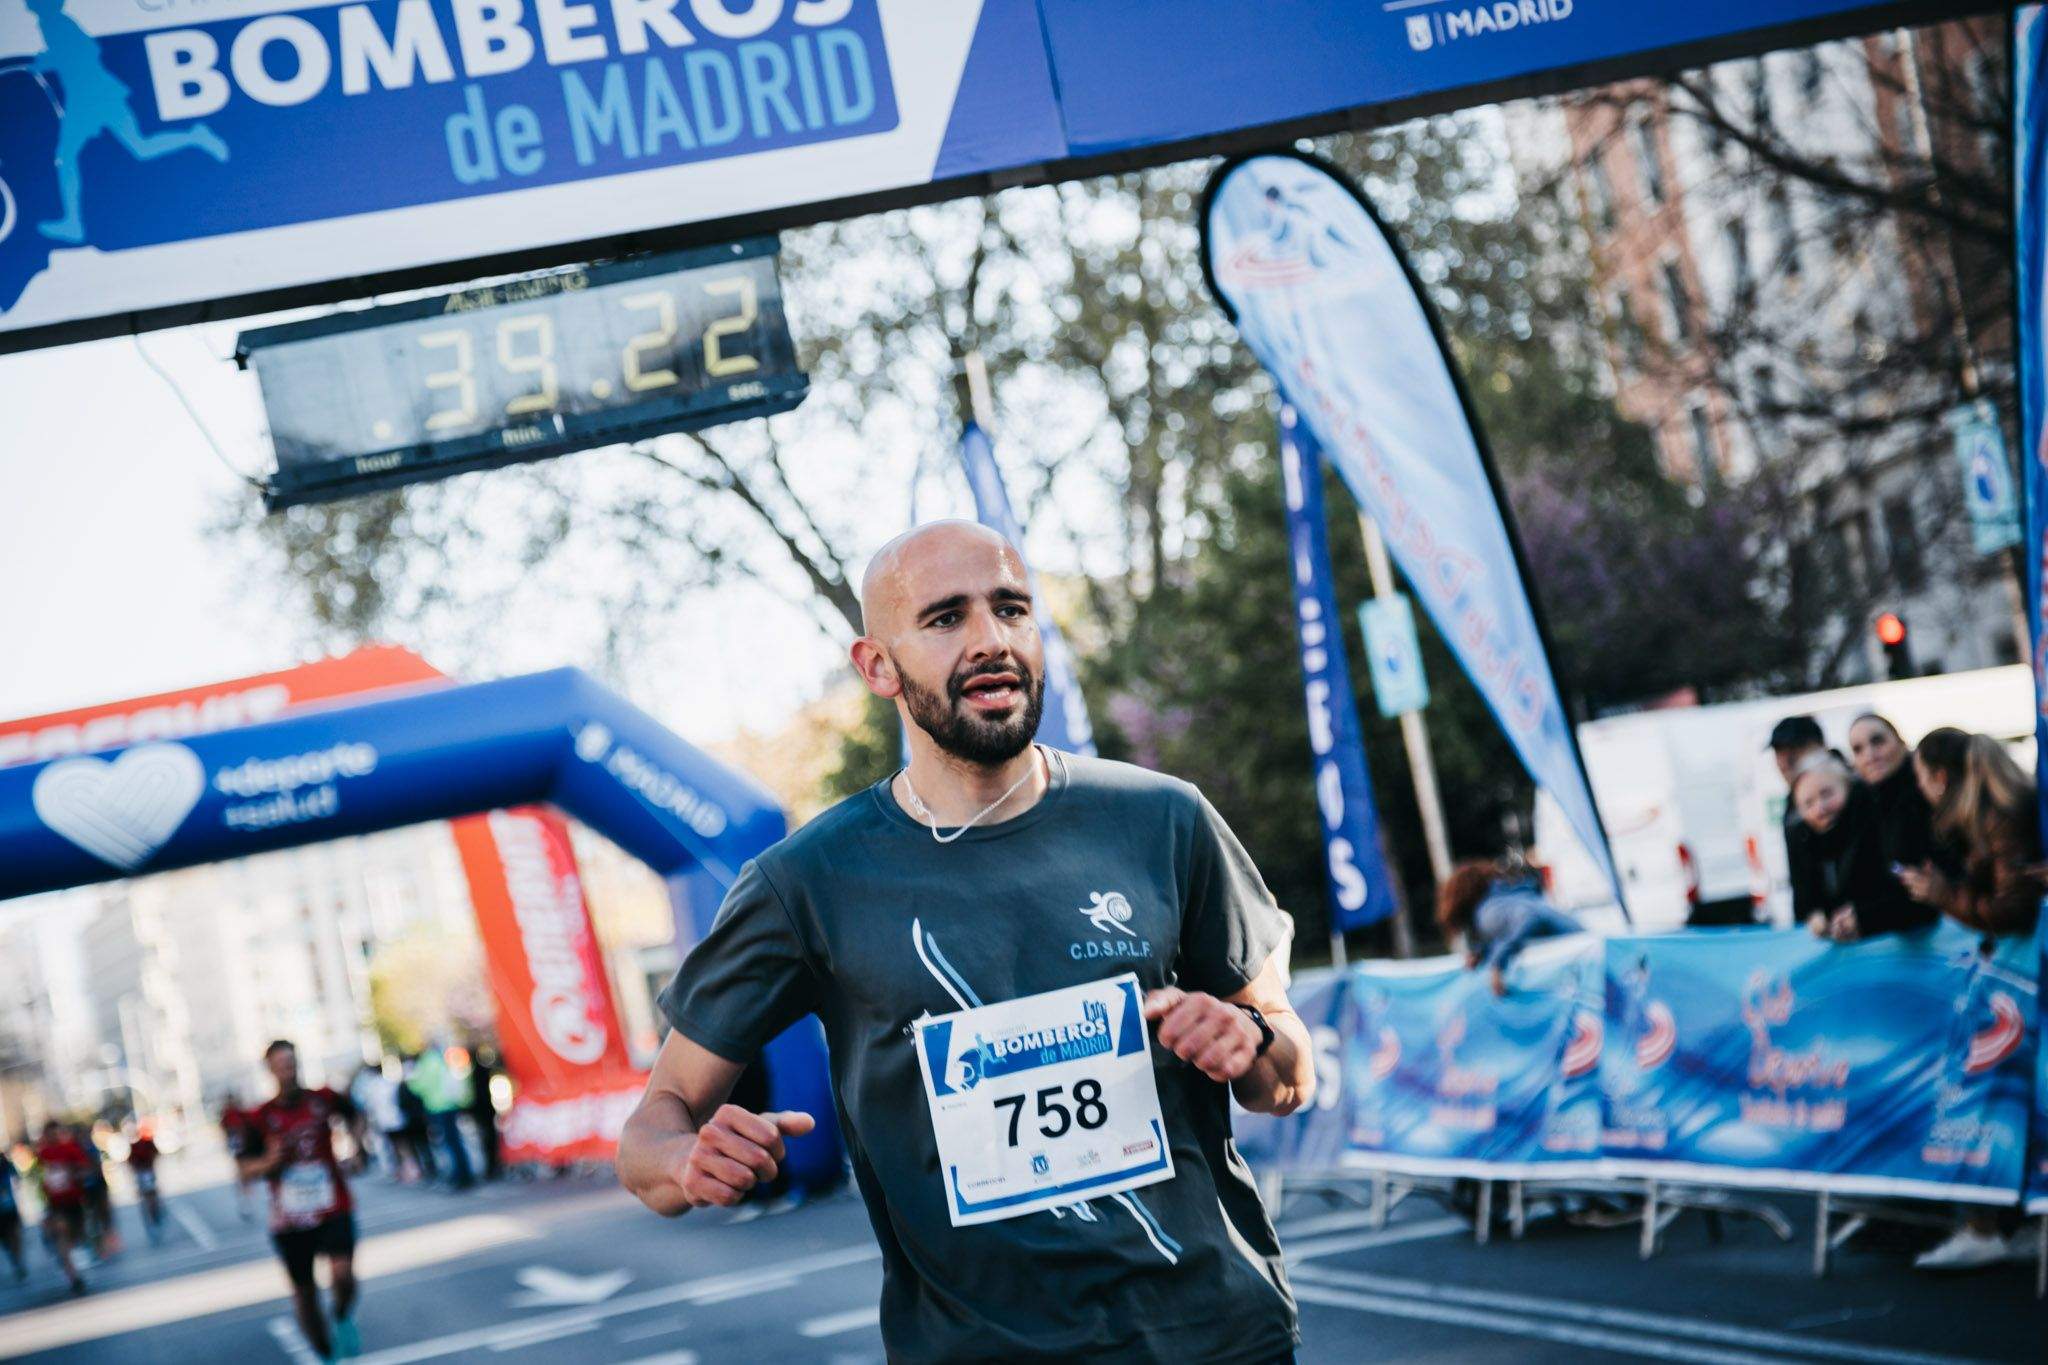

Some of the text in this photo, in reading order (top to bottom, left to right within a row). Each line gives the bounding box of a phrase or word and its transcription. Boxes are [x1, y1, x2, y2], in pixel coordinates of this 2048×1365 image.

[1445, 0, 1574, 40] MADRID
[144, 0, 854, 122] BOMBER
[444, 28, 877, 185] de MADRID
[993, 1017, 1107, 1058] BOMBEROS
[1040, 1033, 1110, 1064] de MADRID
[993, 1078, 1108, 1148] 758
